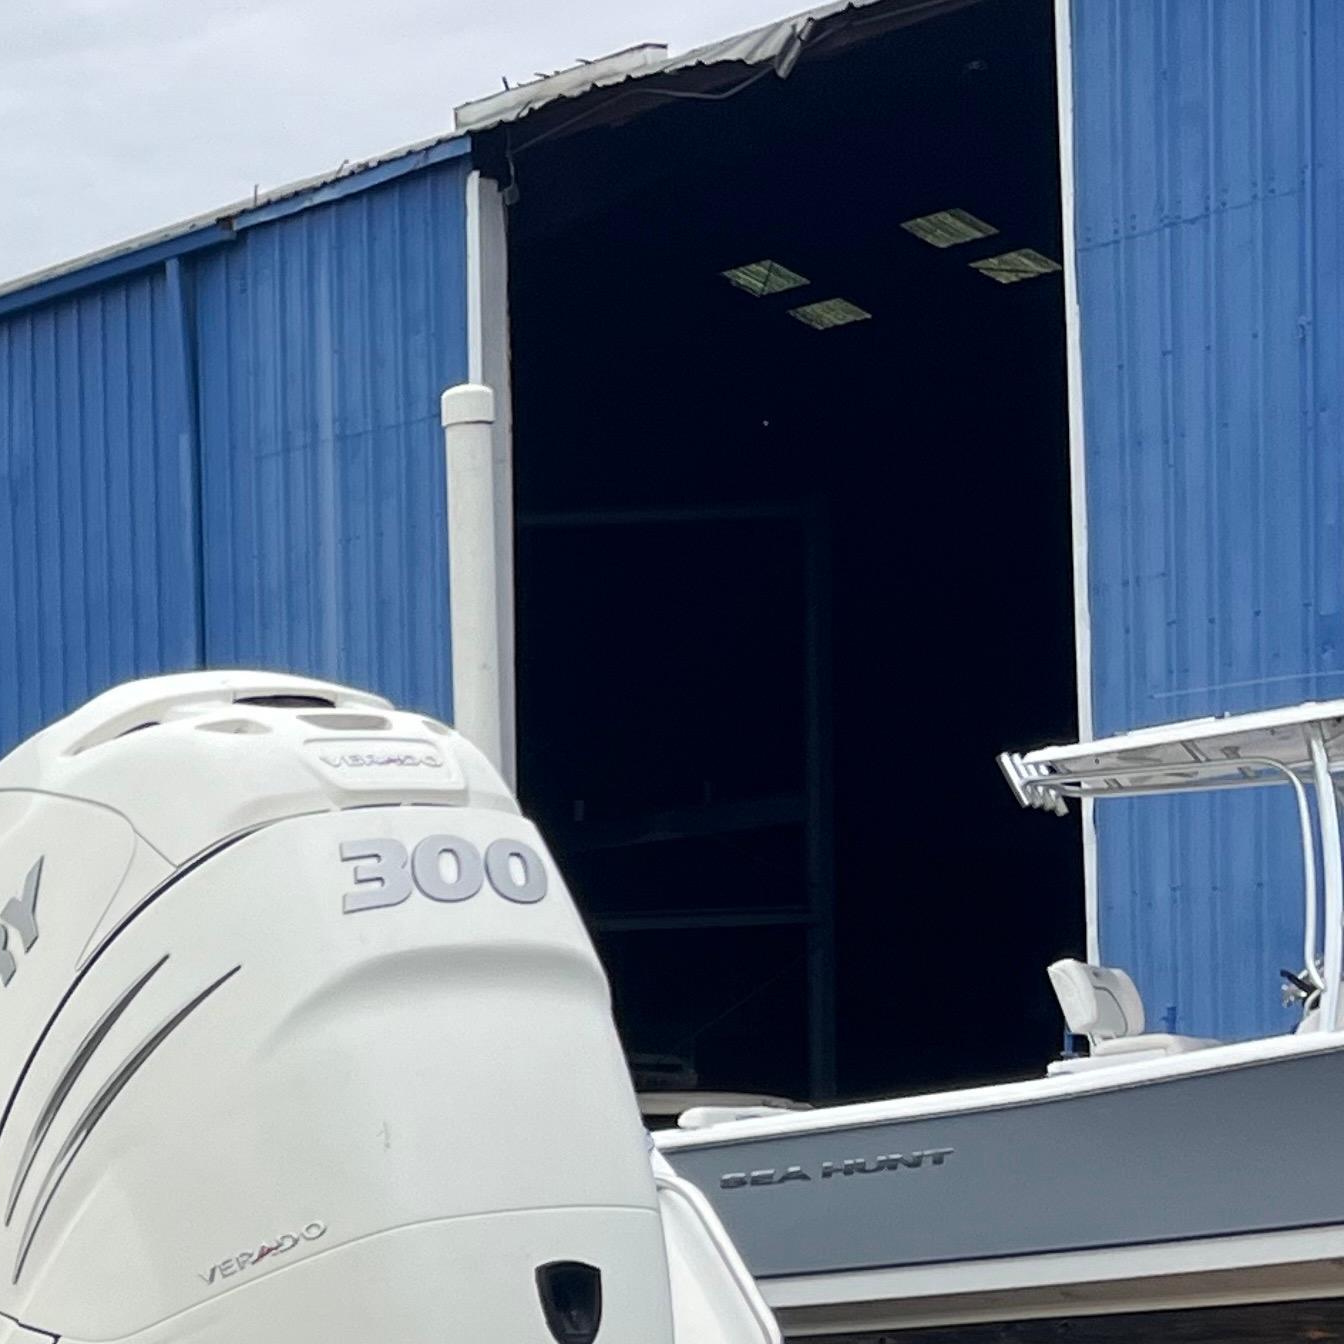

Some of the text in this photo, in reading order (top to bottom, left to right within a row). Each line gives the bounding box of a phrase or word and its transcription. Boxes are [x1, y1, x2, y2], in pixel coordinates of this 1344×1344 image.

[339, 834, 549, 915] 300
[720, 1147, 955, 1189] SEA HUNT
[198, 1222, 328, 1286] VERADO
